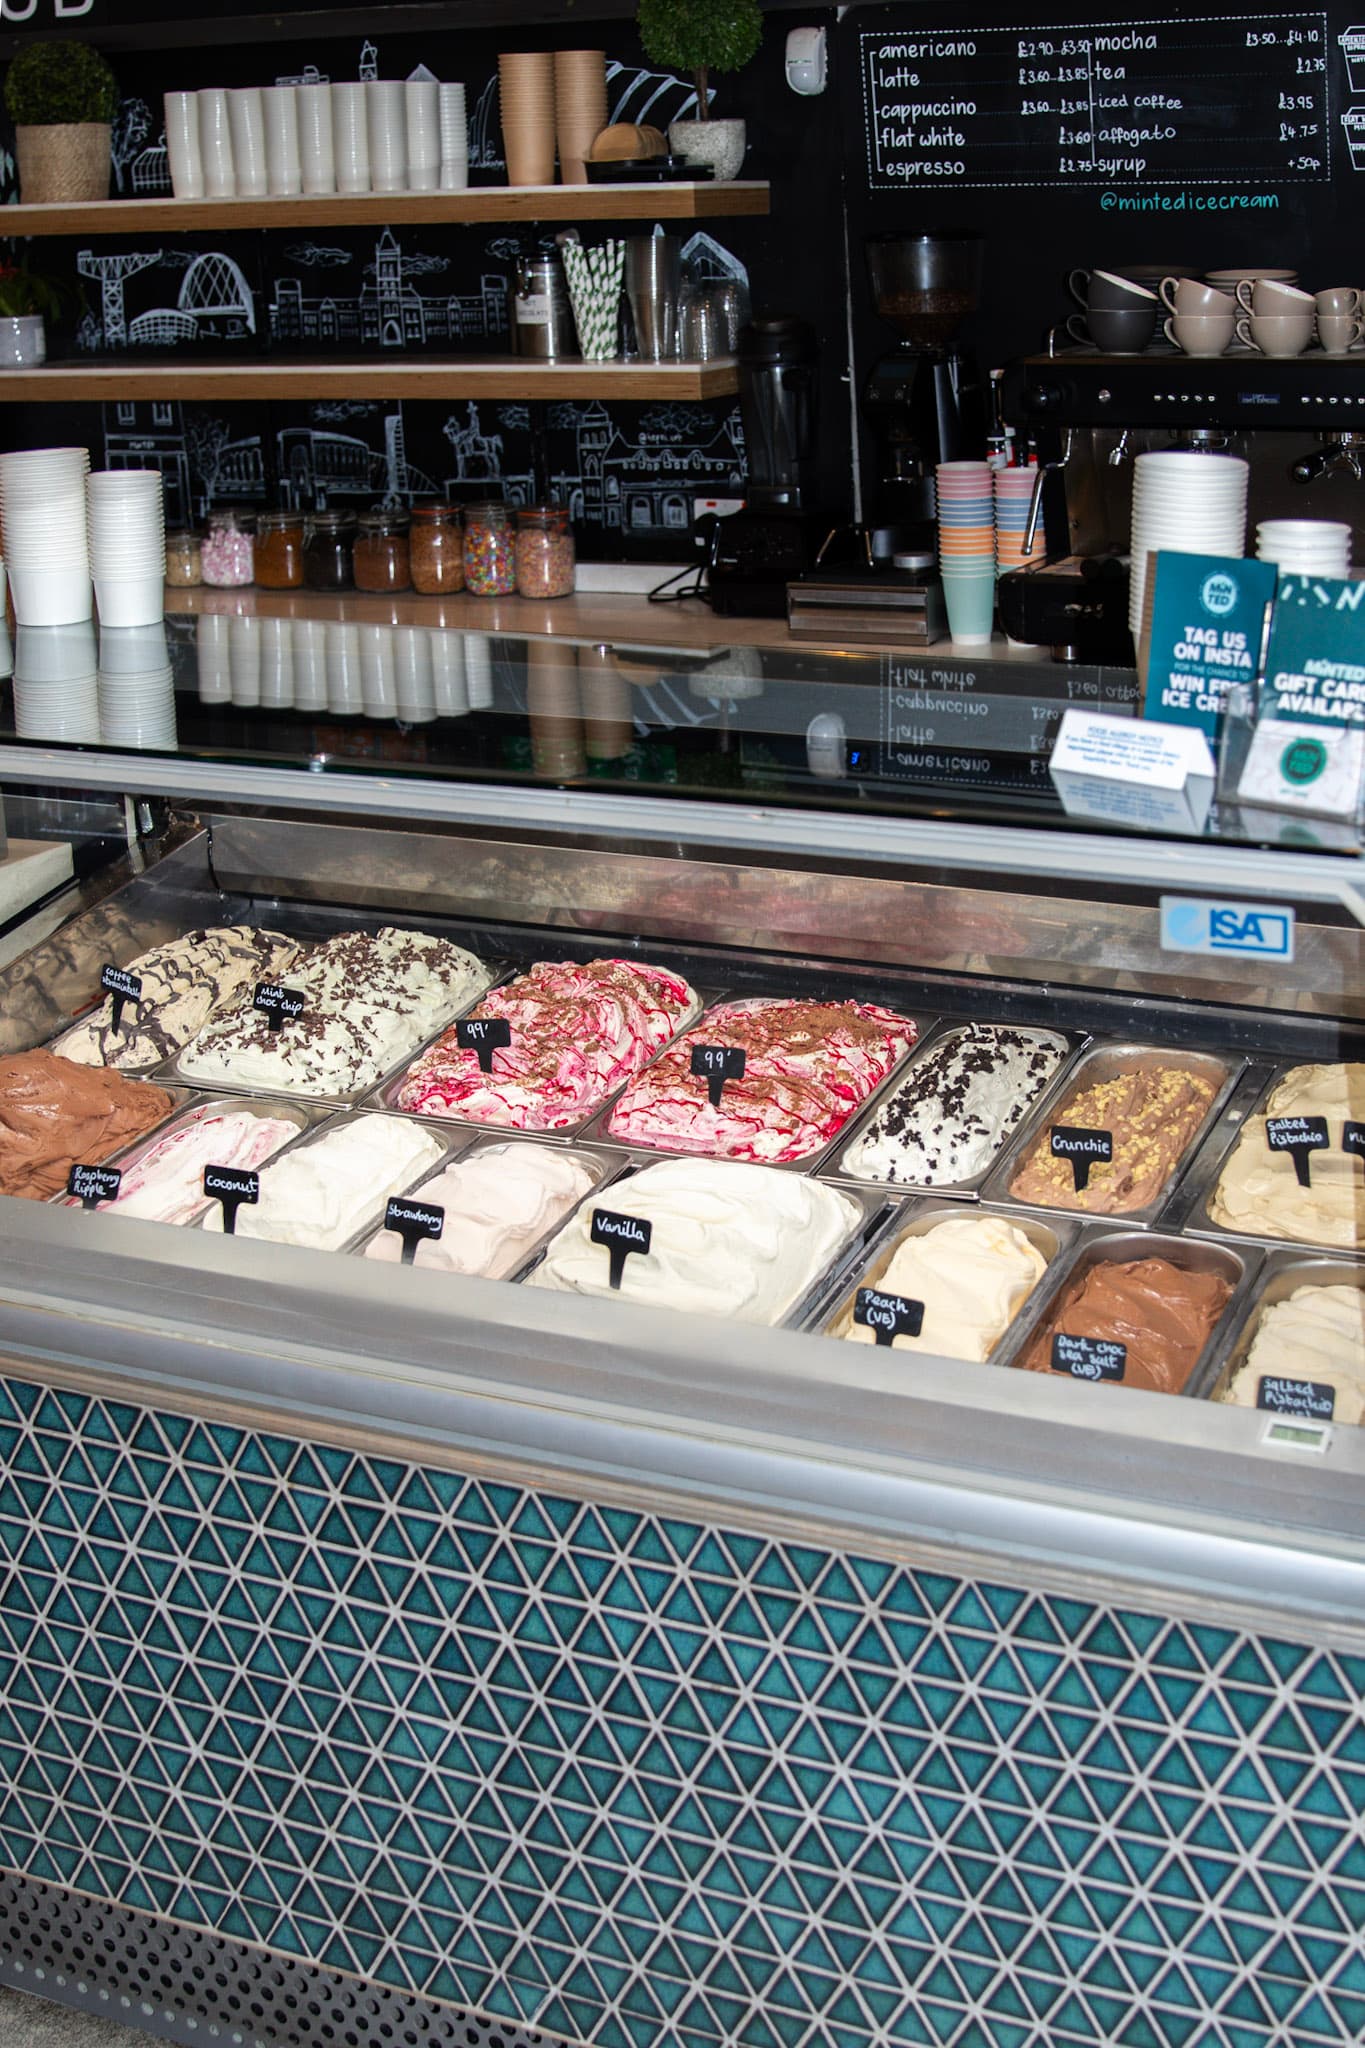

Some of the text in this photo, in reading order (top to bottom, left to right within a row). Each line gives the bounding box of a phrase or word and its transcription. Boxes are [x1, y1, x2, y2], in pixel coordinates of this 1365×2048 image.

[879, 39, 976, 59] americano
[1094, 31, 1157, 50] mocha
[880, 67, 920, 87] latte
[1094, 61, 1126, 80] tea
[881, 96, 976, 123] cappuccino
[1099, 94, 1183, 110] iced coffee
[1278, 92, 1314, 110] £3.95
[881, 126, 965, 147] flat white
[1099, 125, 1176, 147] affogato
[1280, 123, 1317, 142] £4.75
[886, 160, 965, 182] espresso
[1097, 158, 1146, 177] syrup
[1100, 192, 1279, 211] @mintedicecream
[1184, 626, 1247, 649] TAG US
[1174, 643, 1252, 668] ON INSTA
[1169, 672, 1204, 692] WIN
[1274, 672, 1317, 695] GIFT
[1161, 689, 1191, 708] ICE
[1210, 909, 1264, 942] ISA
[261, 987, 285, 999] Mint
[256, 996, 303, 1016] choc chip
[1267, 1117, 1309, 1132] Salted
[1052, 1135, 1110, 1154] Crunchie
[1269, 1130, 1323, 1146] Pistachio
[74, 1166, 120, 1188] Raspberry
[206, 1175, 259, 1193] Coconut
[73, 1182, 107, 1198] Ripple
[388, 1203, 442, 1231] Strawberry
[596, 1217, 645, 1242] Vanilla
[864, 1290, 909, 1314] Peach
[866, 1307, 896, 1330] (VE)
[1058, 1334, 1127, 1356] Dark choc
[1089, 1352, 1119, 1369] salt
